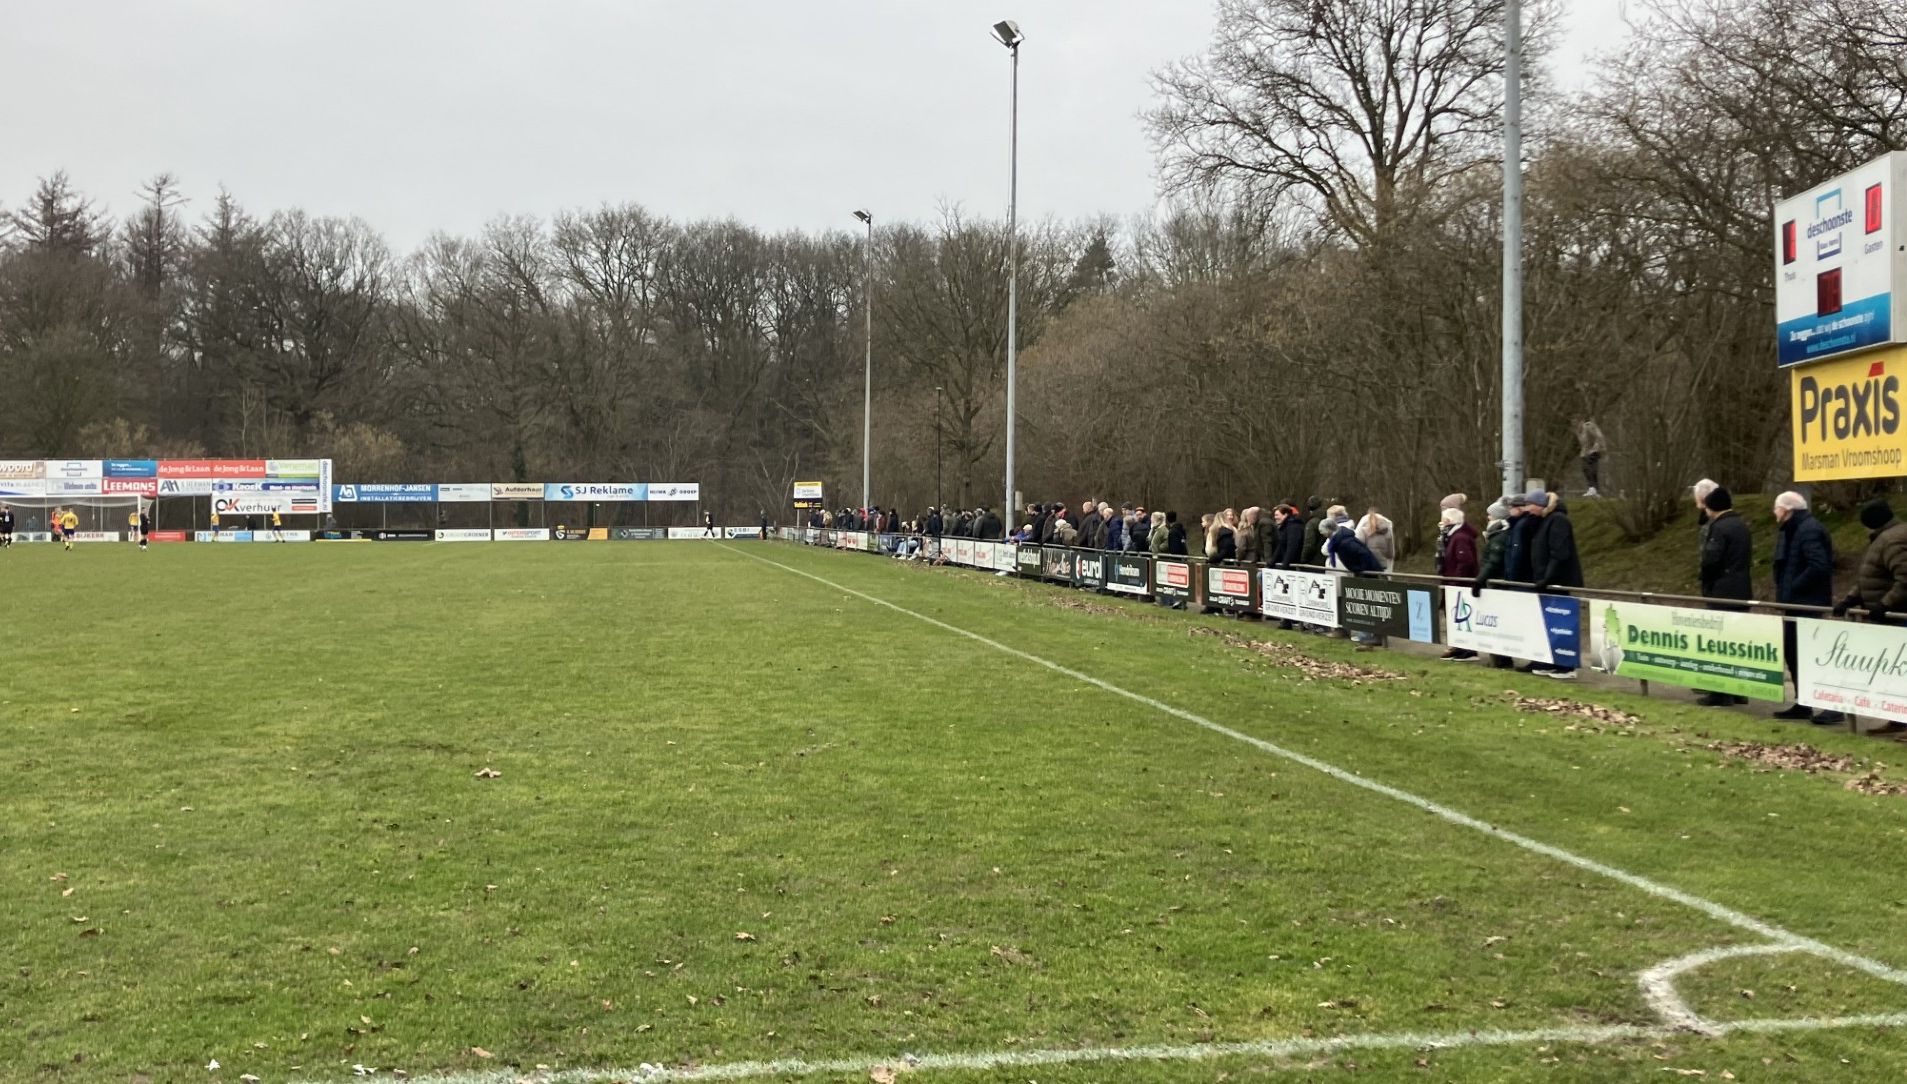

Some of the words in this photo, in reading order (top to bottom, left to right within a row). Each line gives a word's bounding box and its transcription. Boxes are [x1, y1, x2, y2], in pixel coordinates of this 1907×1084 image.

[1807, 208, 1853, 239] deschoonste
[1864, 240, 1883, 255] Gasten
[1800, 374, 1900, 444] Praxis
[1801, 452, 1839, 471] Marsman
[1841, 445, 1902, 469] Vroomshoop
[103, 480, 156, 491] LEEMANS
[575, 486, 587, 494] SJ
[590, 485, 634, 494] Reklame
[1081, 555, 1103, 579] eurol
[1365, 589, 1401, 605] MOMENTEN
[1345, 601, 1369, 616] SCOREN
[1627, 624, 1688, 650] Dennis
[1696, 633, 1779, 663] Leussink
